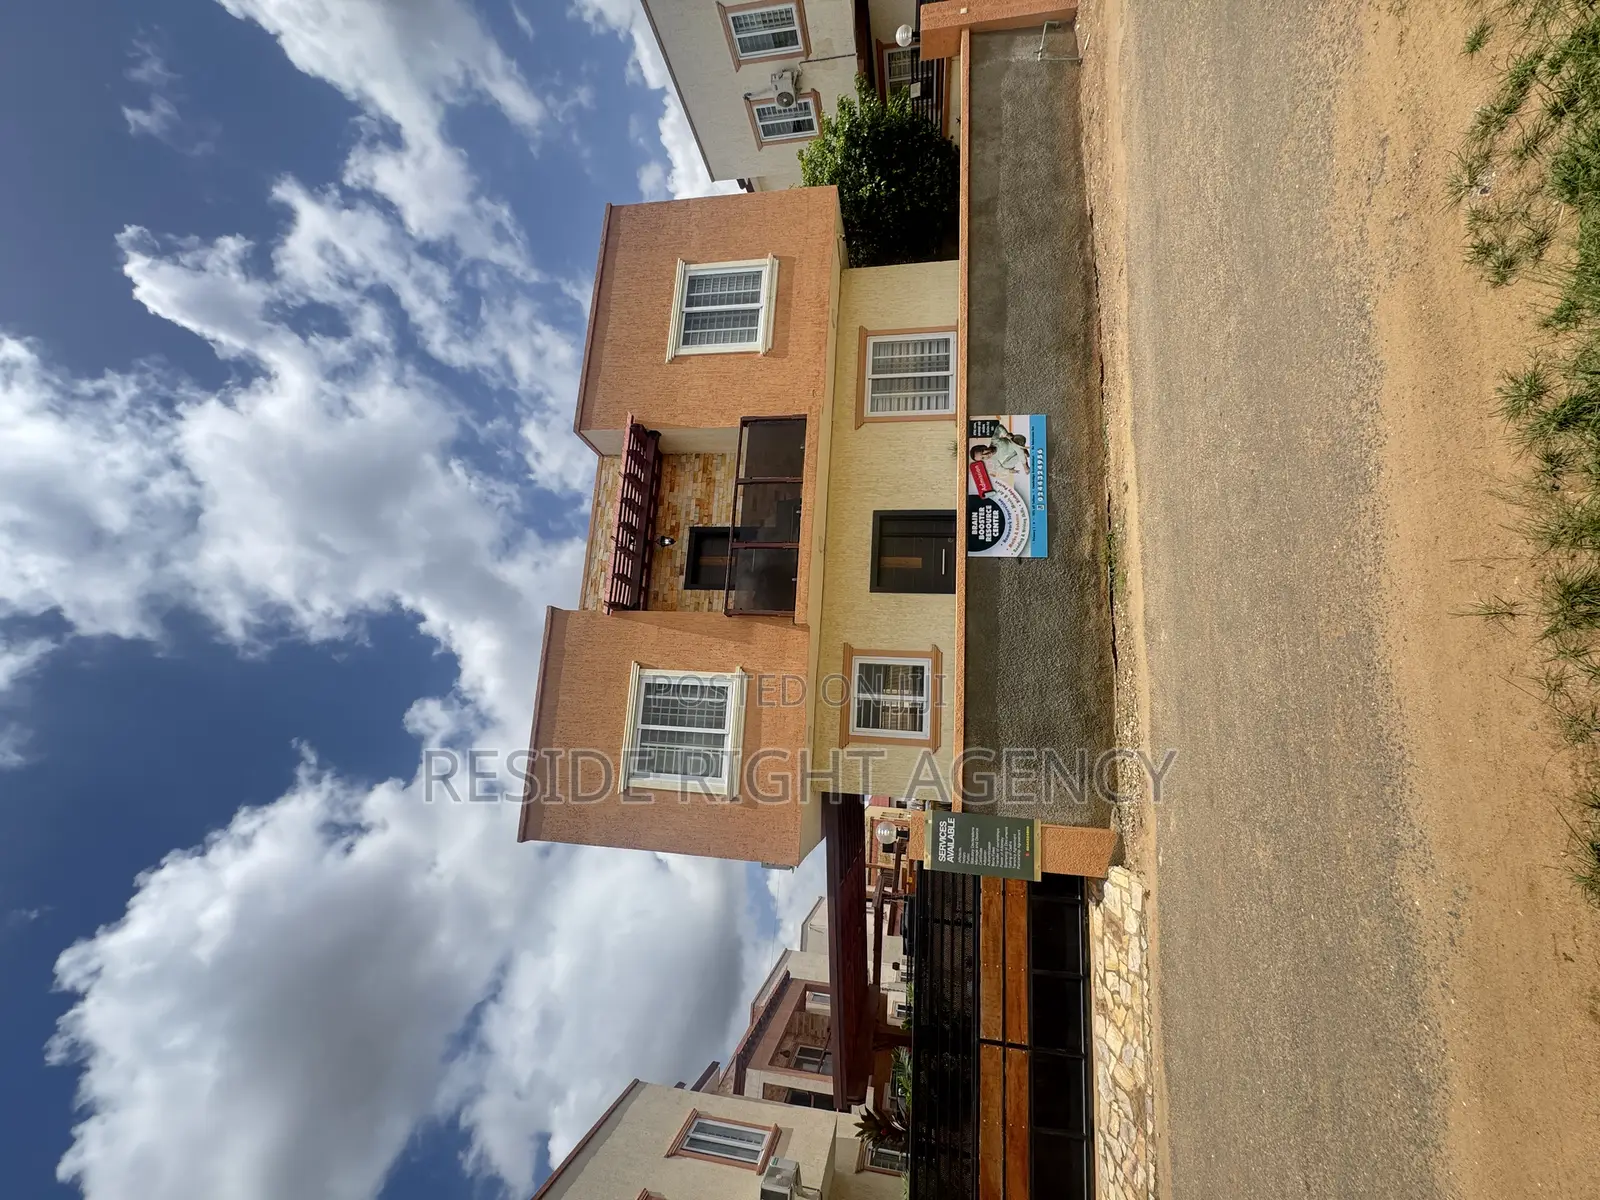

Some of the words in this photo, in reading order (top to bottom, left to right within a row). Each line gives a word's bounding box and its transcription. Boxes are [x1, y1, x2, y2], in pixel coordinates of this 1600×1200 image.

[974, 465, 986, 491] Admission
[938, 821, 947, 862] SERVICES
[947, 818, 955, 863] AVAILABLE
